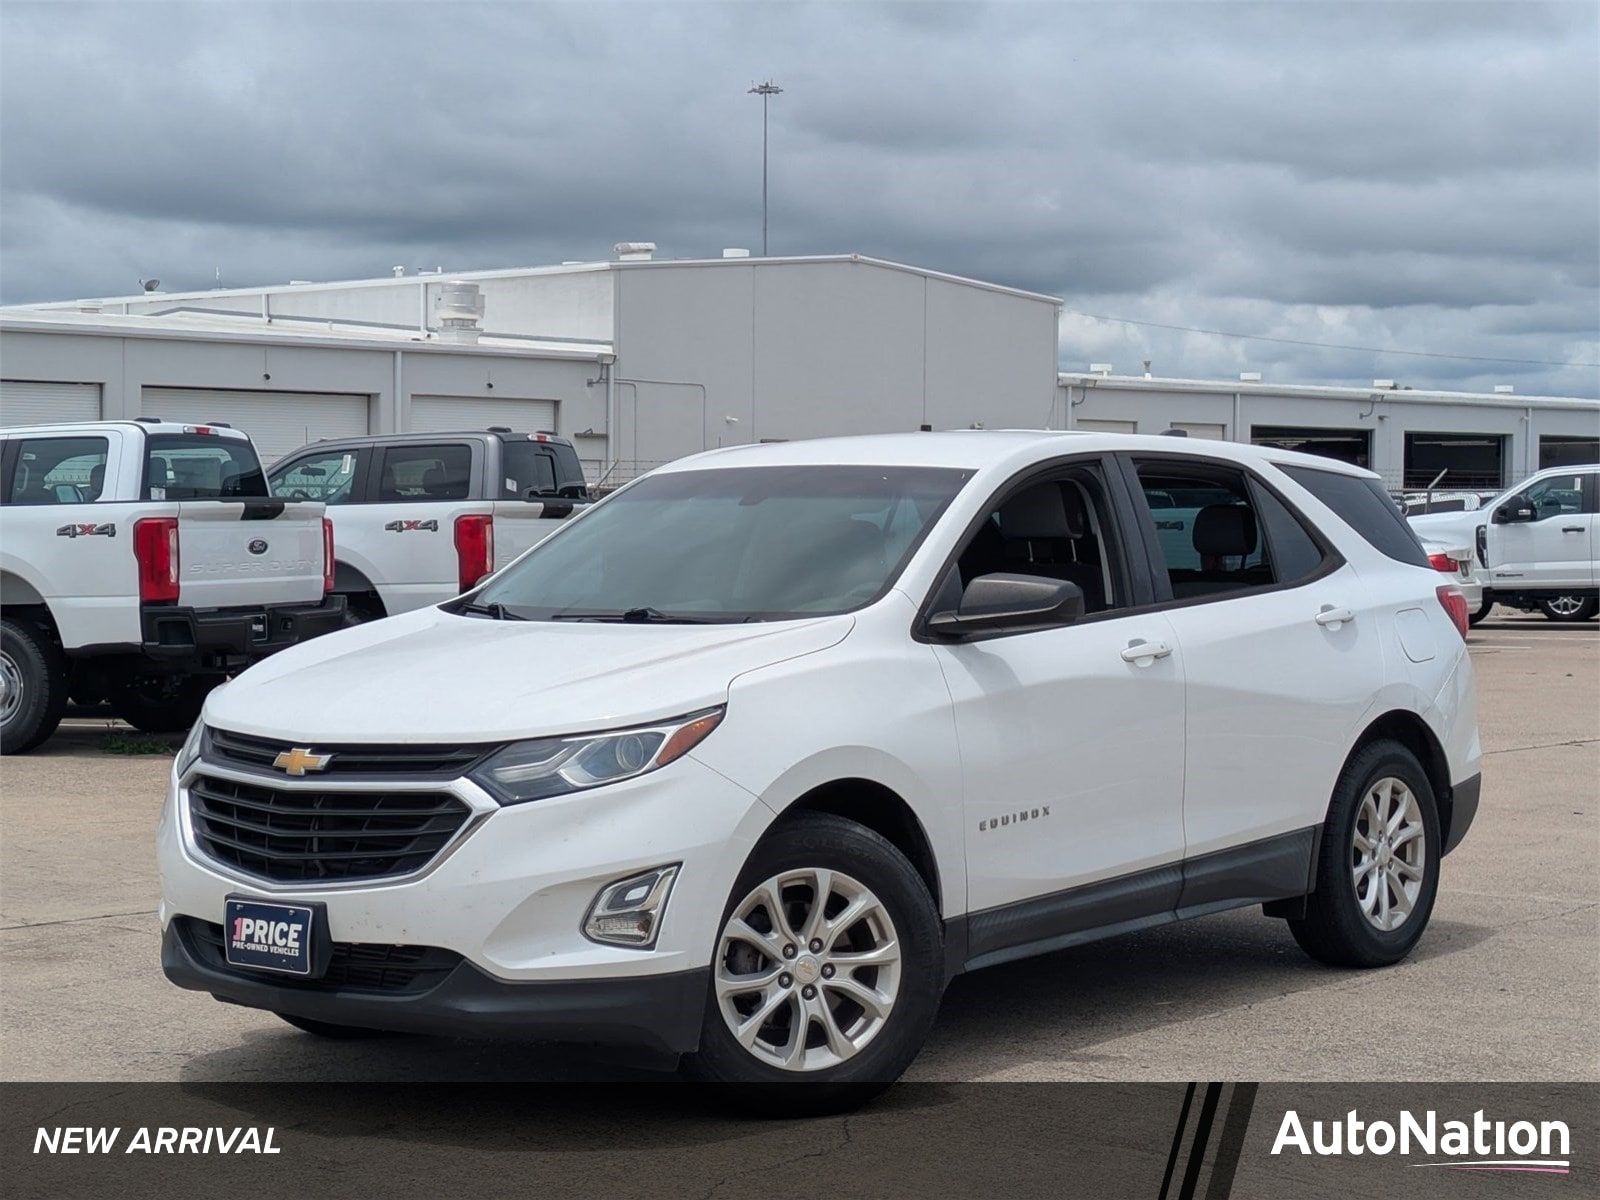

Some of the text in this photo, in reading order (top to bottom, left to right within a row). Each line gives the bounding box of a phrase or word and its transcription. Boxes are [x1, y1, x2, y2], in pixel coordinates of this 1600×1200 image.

[189, 559, 318, 575] SUPER DUTY
[979, 806, 1050, 831] EQUINOX
[232, 941, 299, 956] PRE-OWNED VEHICLES
